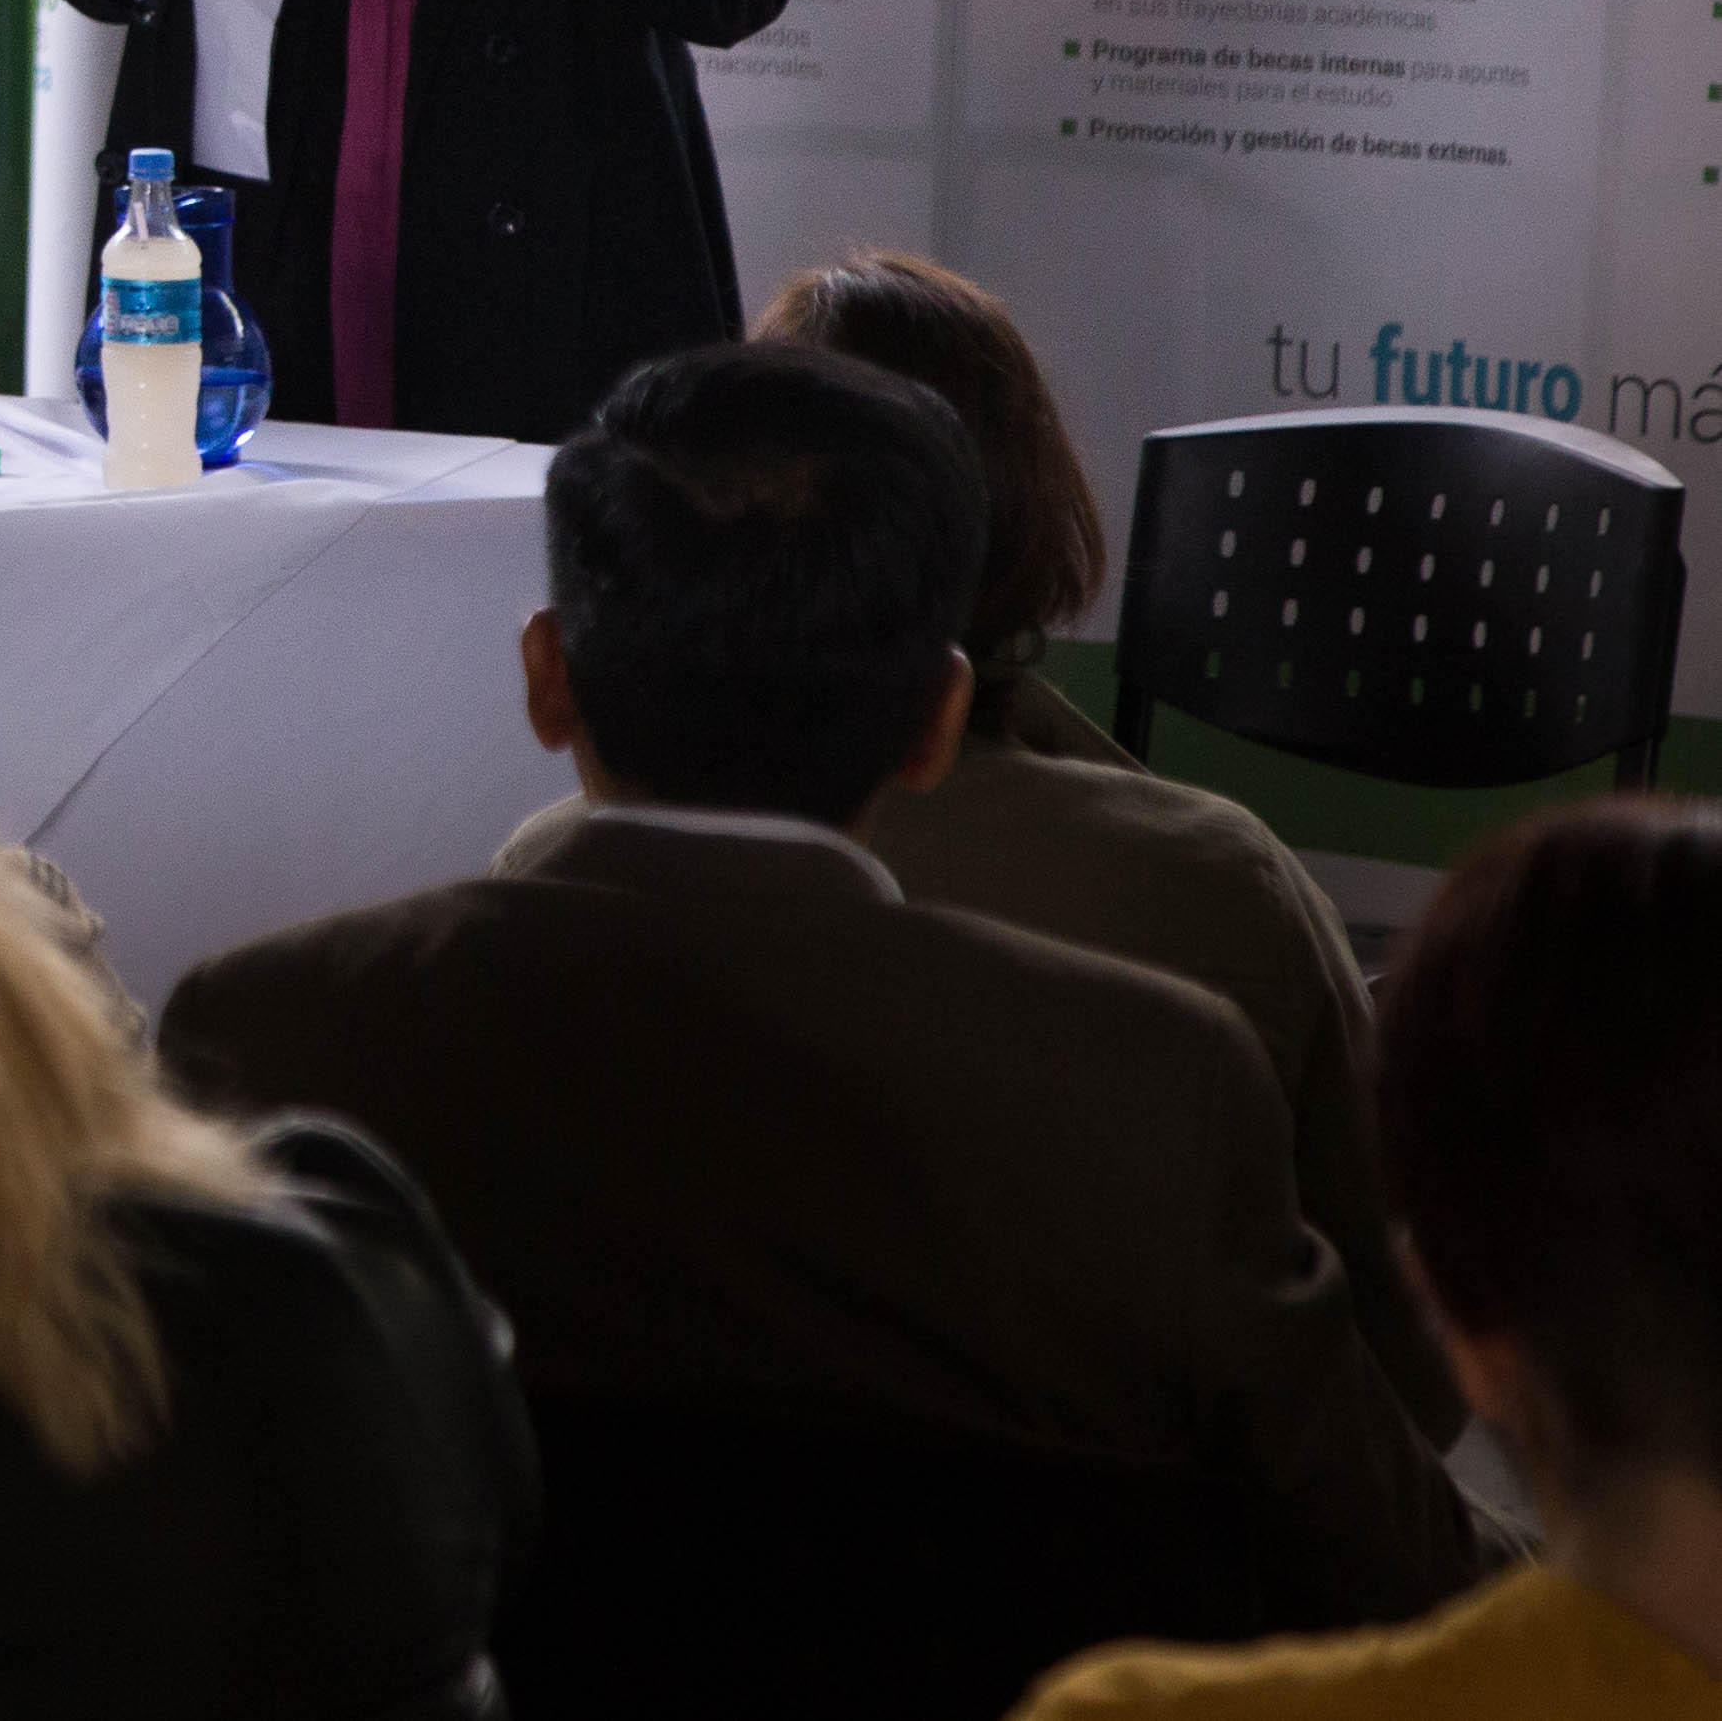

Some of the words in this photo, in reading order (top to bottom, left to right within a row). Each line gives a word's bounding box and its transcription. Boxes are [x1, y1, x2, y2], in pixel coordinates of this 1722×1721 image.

[1092, 38, 1207, 67] Programa
[1213, 46, 1241, 67] de
[1248, 46, 1314, 71] becas
[1320, 52, 1406, 77] internas
[1089, 118, 1217, 145] Promoción
[1223, 130, 1236, 153] y
[1241, 128, 1325, 155] gestión
[1331, 131, 1356, 153] de
[1362, 133, 1422, 159] becas
[1265, 323, 1342, 400] tu
[1369, 322, 1583, 423] futuro
